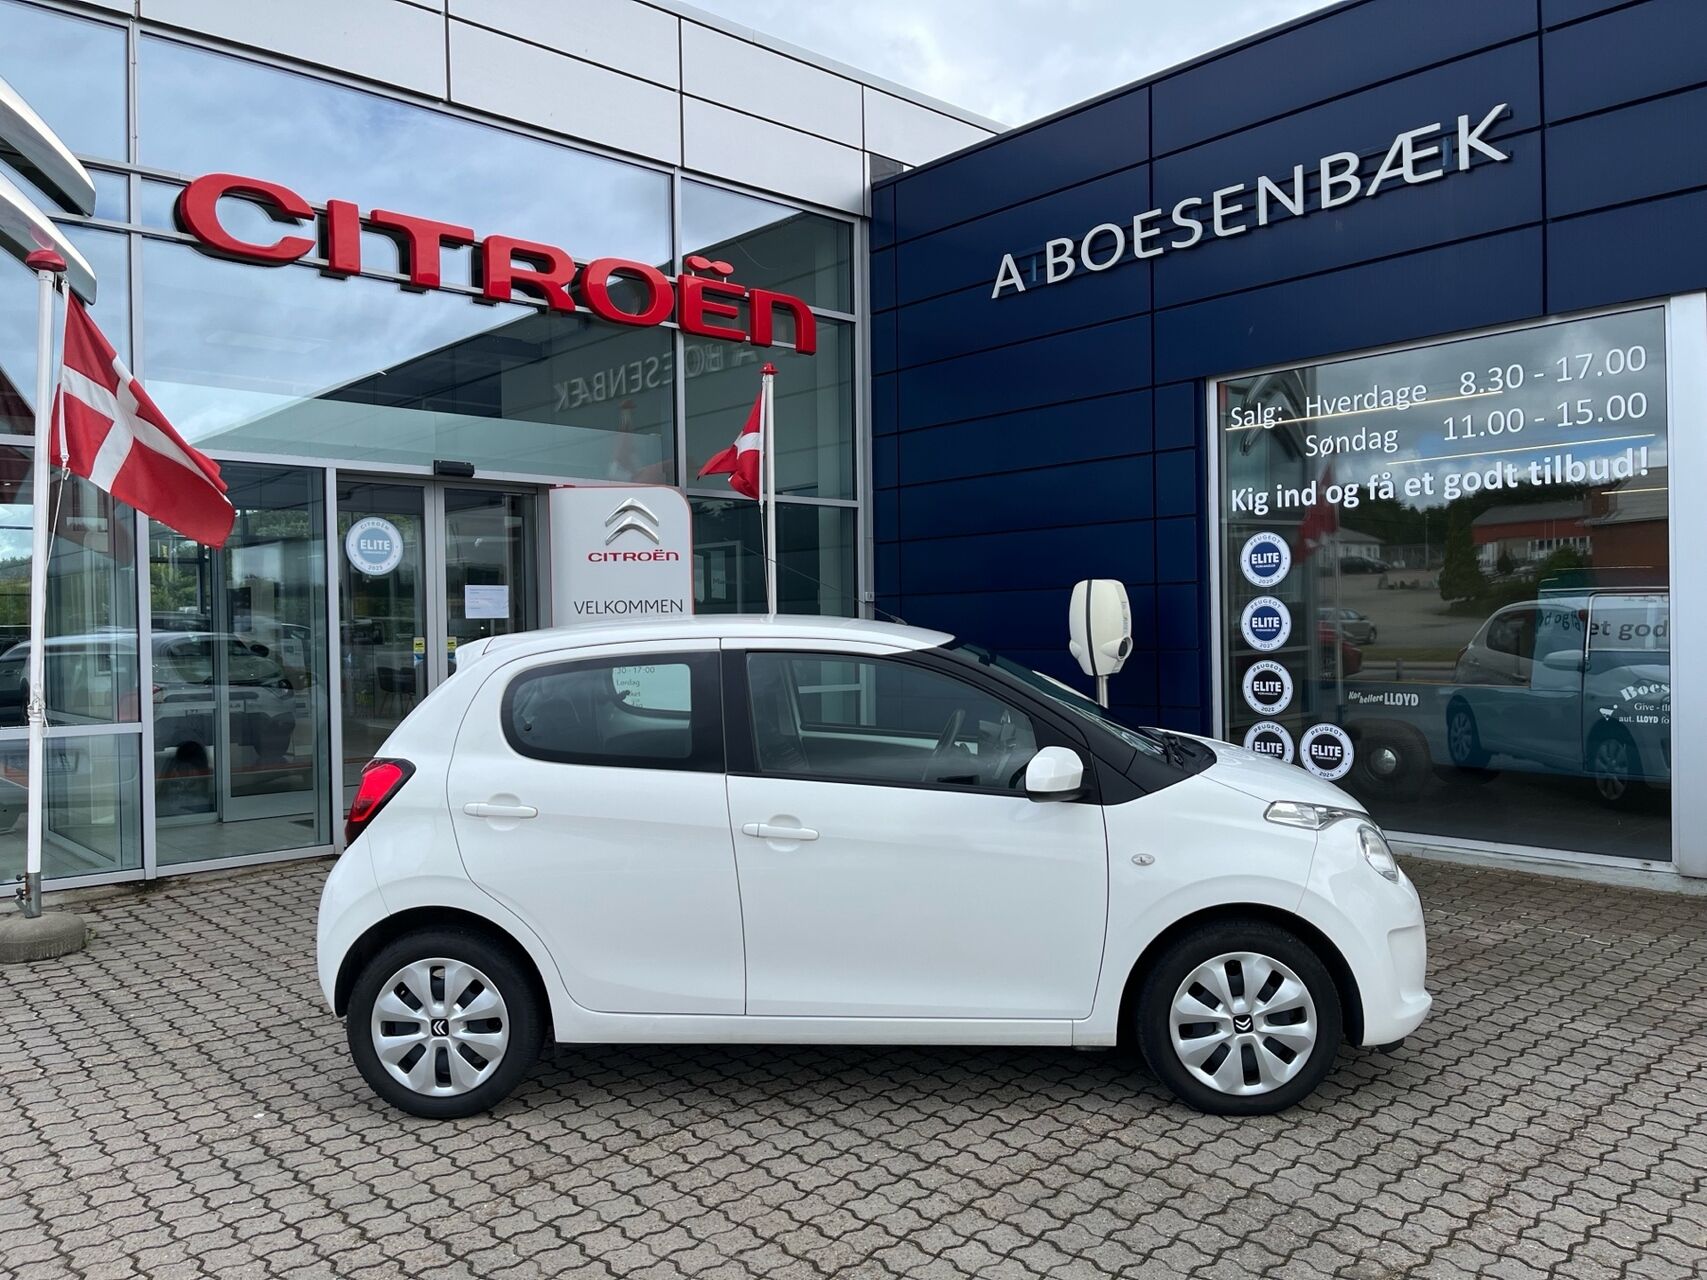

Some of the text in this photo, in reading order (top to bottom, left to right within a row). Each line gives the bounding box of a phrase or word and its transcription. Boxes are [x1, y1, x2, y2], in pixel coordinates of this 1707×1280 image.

[991, 103, 1510, 300] A BOESENBÆK
[1231, 402, 1283, 429] Salg:
[1306, 384, 1428, 418] Hverdage
[1459, 363, 1525, 397] 8.30
[1556, 345, 1647, 383] 17.00
[1305, 427, 1399, 458] Søndag
[1443, 408, 1525, 441] 11.00
[1556, 392, 1648, 428] 15.00
[1231, 446, 1650, 515] Kig ind og få et godt tilbud!
[360, 539, 391, 551] ELITE
[1249, 534, 1281, 546] PEUGEOT
[1251, 552, 1280, 565] ELITE
[574, 599, 684, 615] VELKOMMEN
[1250, 598, 1282, 610] PEUGEOT
[1251, 616, 1280, 629] ELITE
[1252, 663, 1283, 673] PEUGEOT
[1253, 680, 1282, 693] ELITE
[1384, 692, 1419, 706] LLOYD
[1634, 702, 1655, 711] Give
[1636, 715, 1659, 724] LLOYD
[1253, 723, 1284, 733] PEUGEOT
[1310, 726, 1343, 737] PEUGEOT
[1254, 741, 1283, 754] ELITE
[1311, 744, 1342, 757] ELITE
